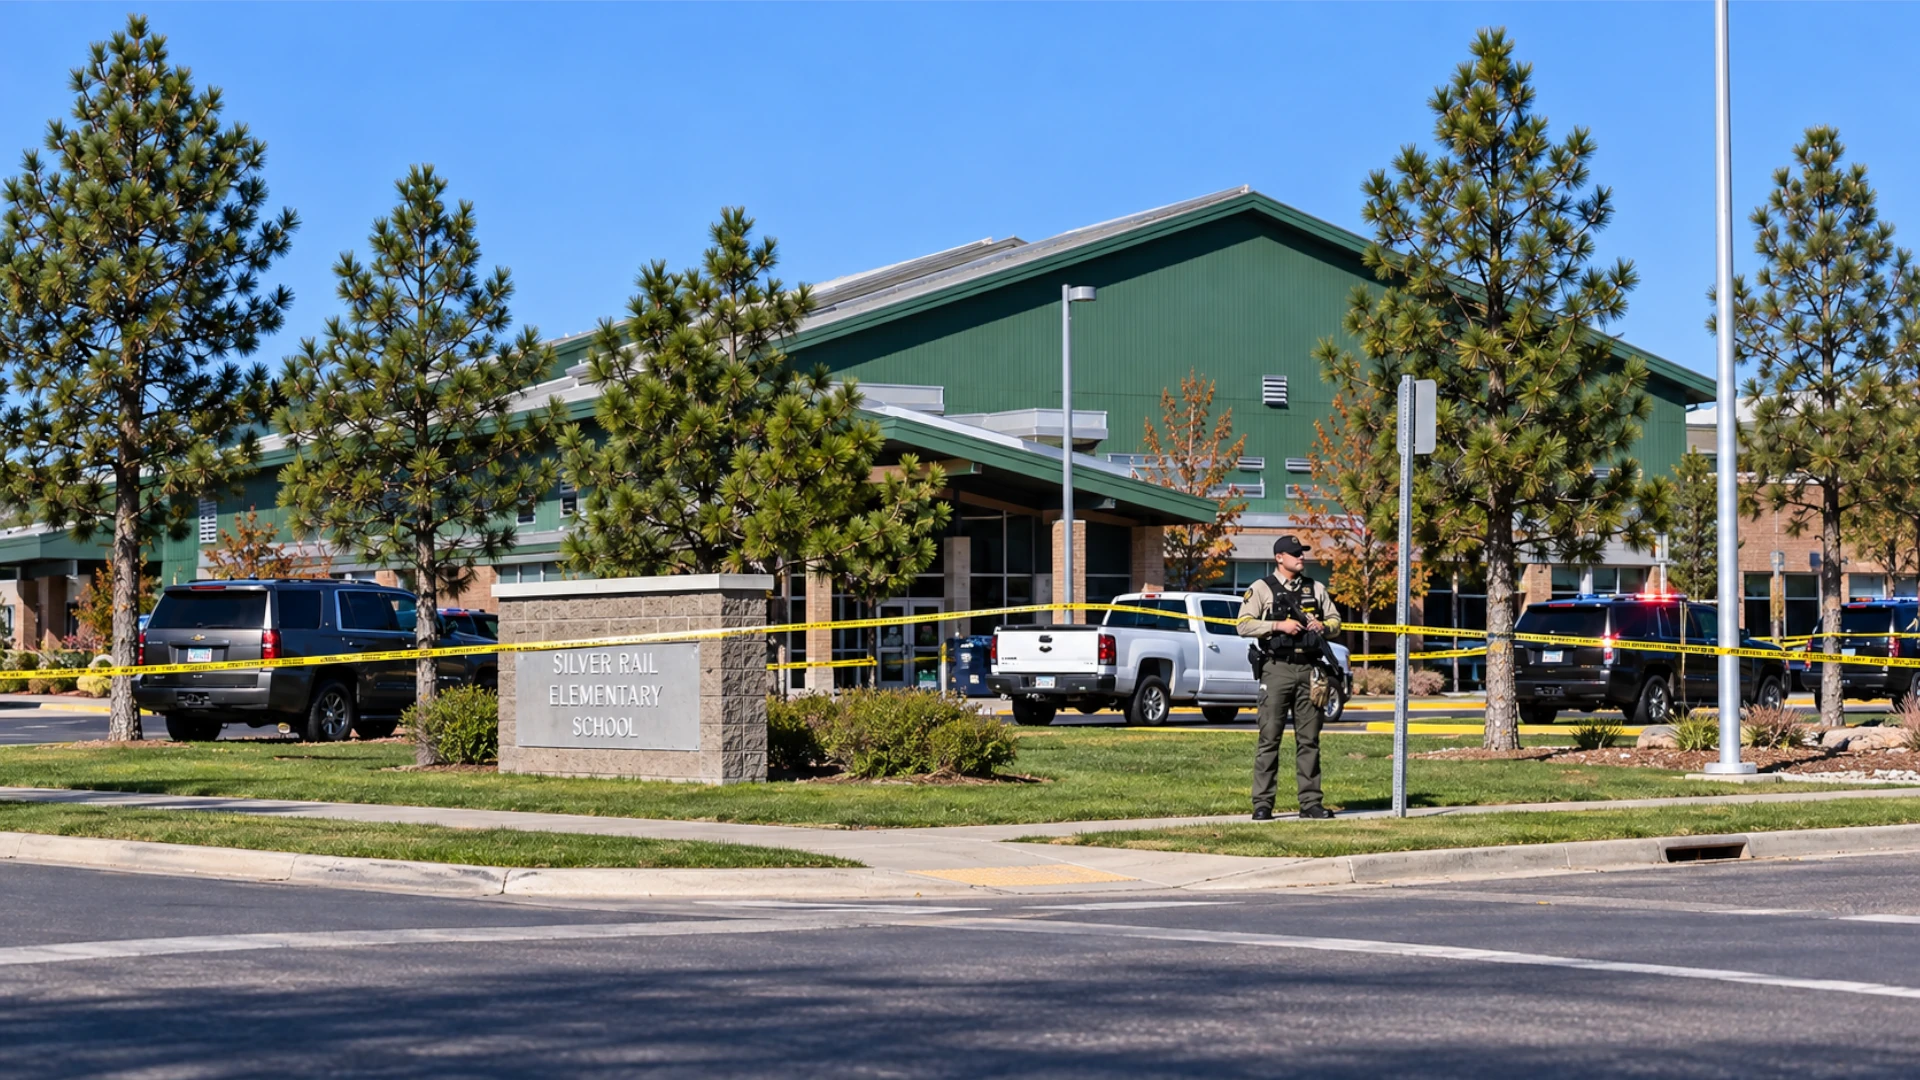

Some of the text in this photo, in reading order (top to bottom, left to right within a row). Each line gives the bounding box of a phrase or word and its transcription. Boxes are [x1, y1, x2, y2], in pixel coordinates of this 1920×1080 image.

[553, 653, 658, 674] SILVER RAIL
[549, 685, 662, 706] ELEMENTARY
[572, 717, 638, 738] SCHOOL
